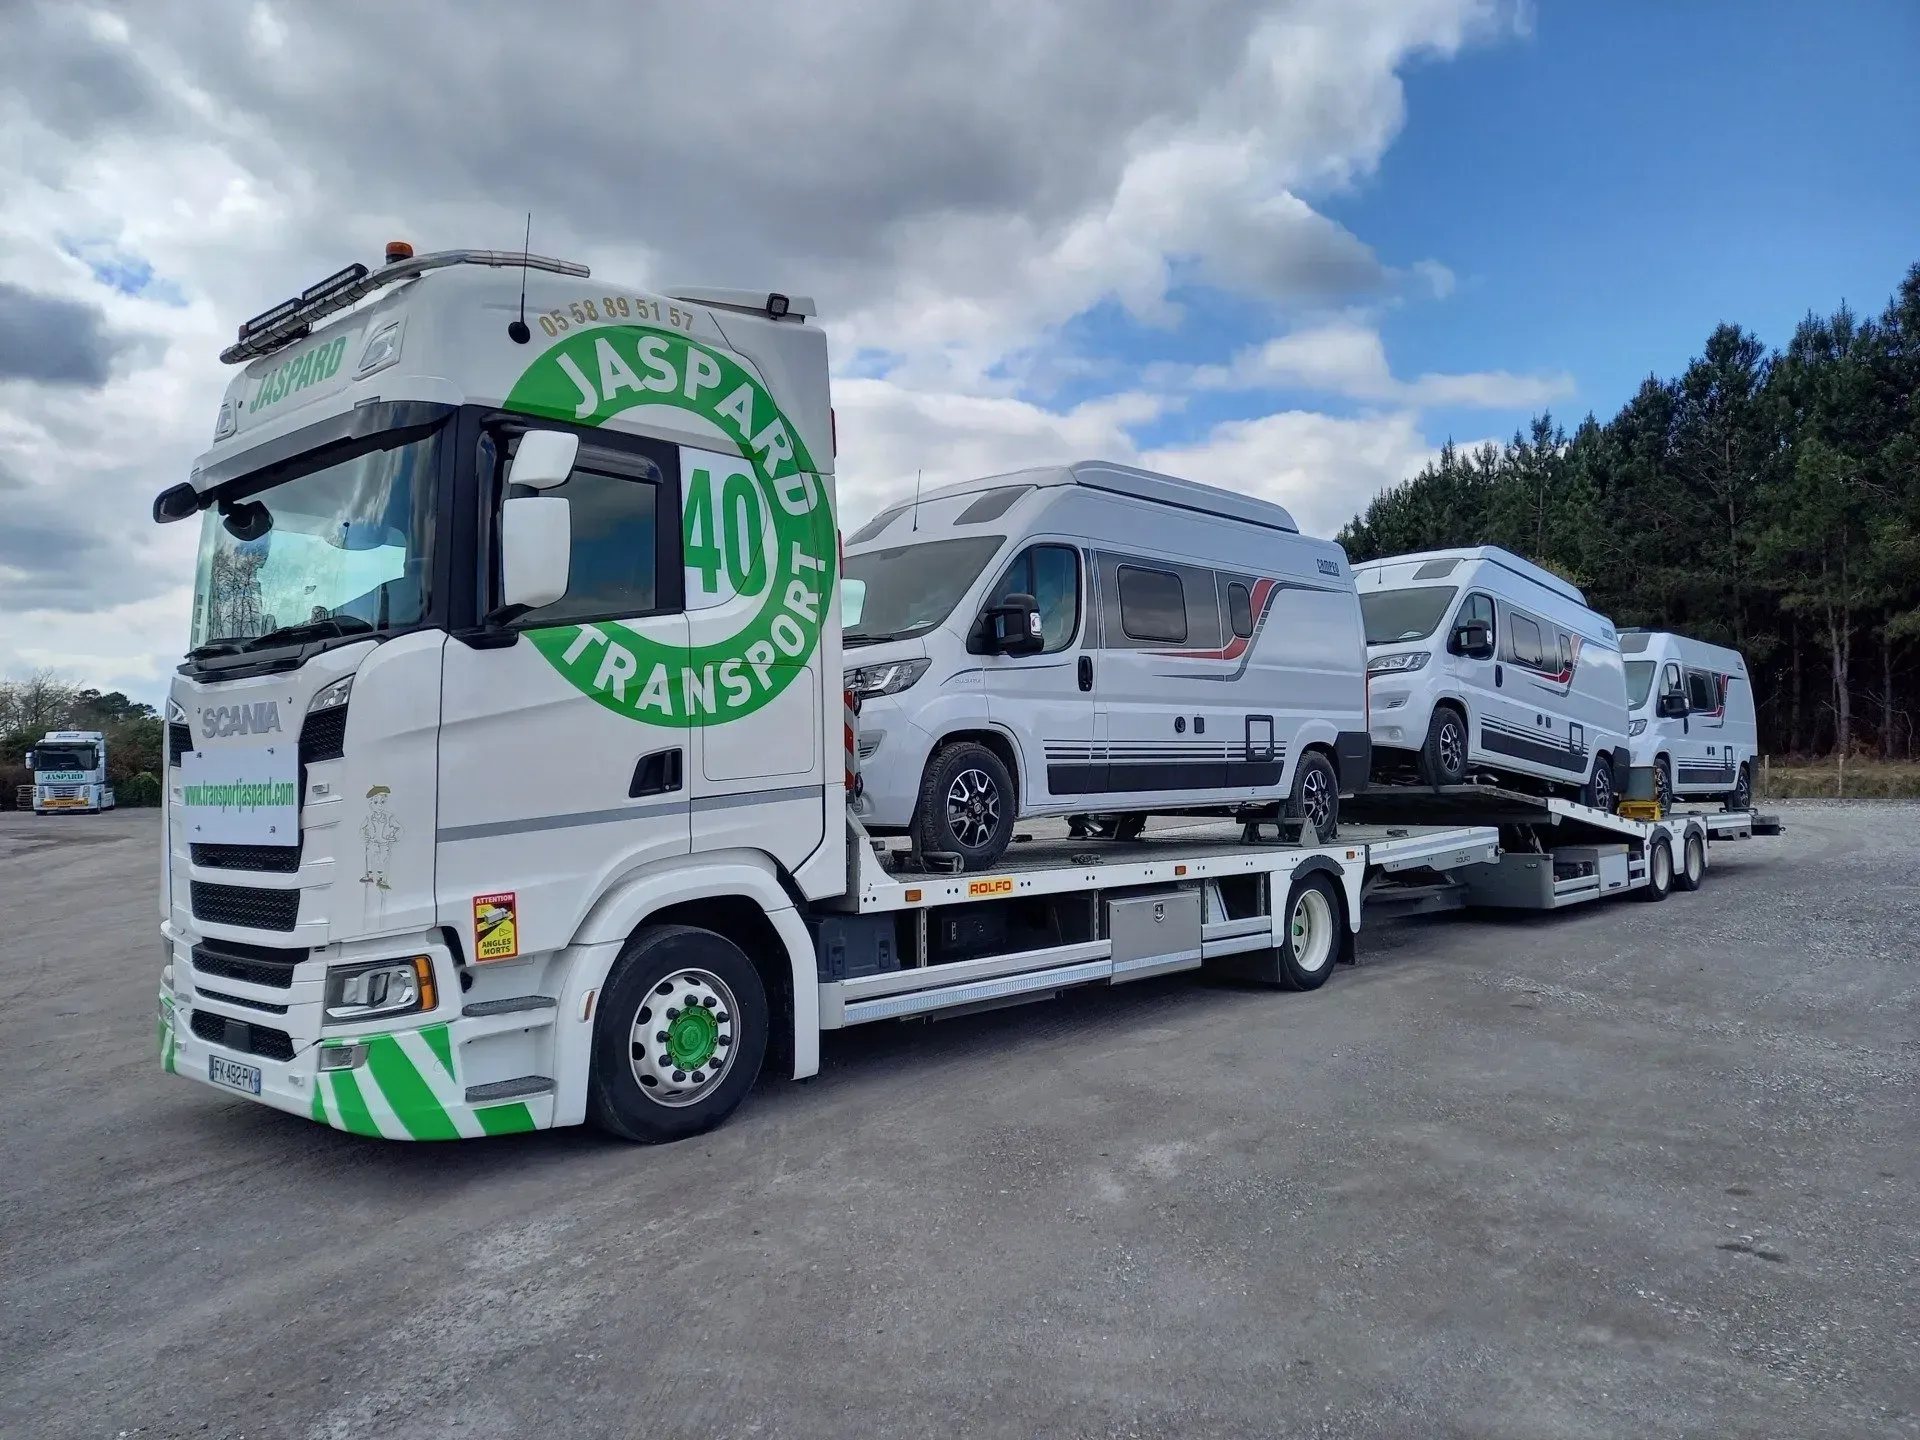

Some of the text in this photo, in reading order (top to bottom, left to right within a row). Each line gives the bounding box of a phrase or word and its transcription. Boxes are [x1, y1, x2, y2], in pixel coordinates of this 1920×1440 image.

[539, 296, 693, 337] 05 58 89 51 57
[249, 336, 347, 414] JASPARD
[556, 336, 818, 516] JASPARD
[683, 468, 767, 597] 40
[561, 541, 826, 716] TRANSPORT
[201, 701, 282, 738] SCANIA
[184, 776, 294, 813] www.transportjaspard.com
[476, 894, 513, 905] ATTENTION
[970, 880, 1011, 894] ROLFO
[481, 937, 512, 949] ANGLES
[483, 946, 511, 956] MORTS
